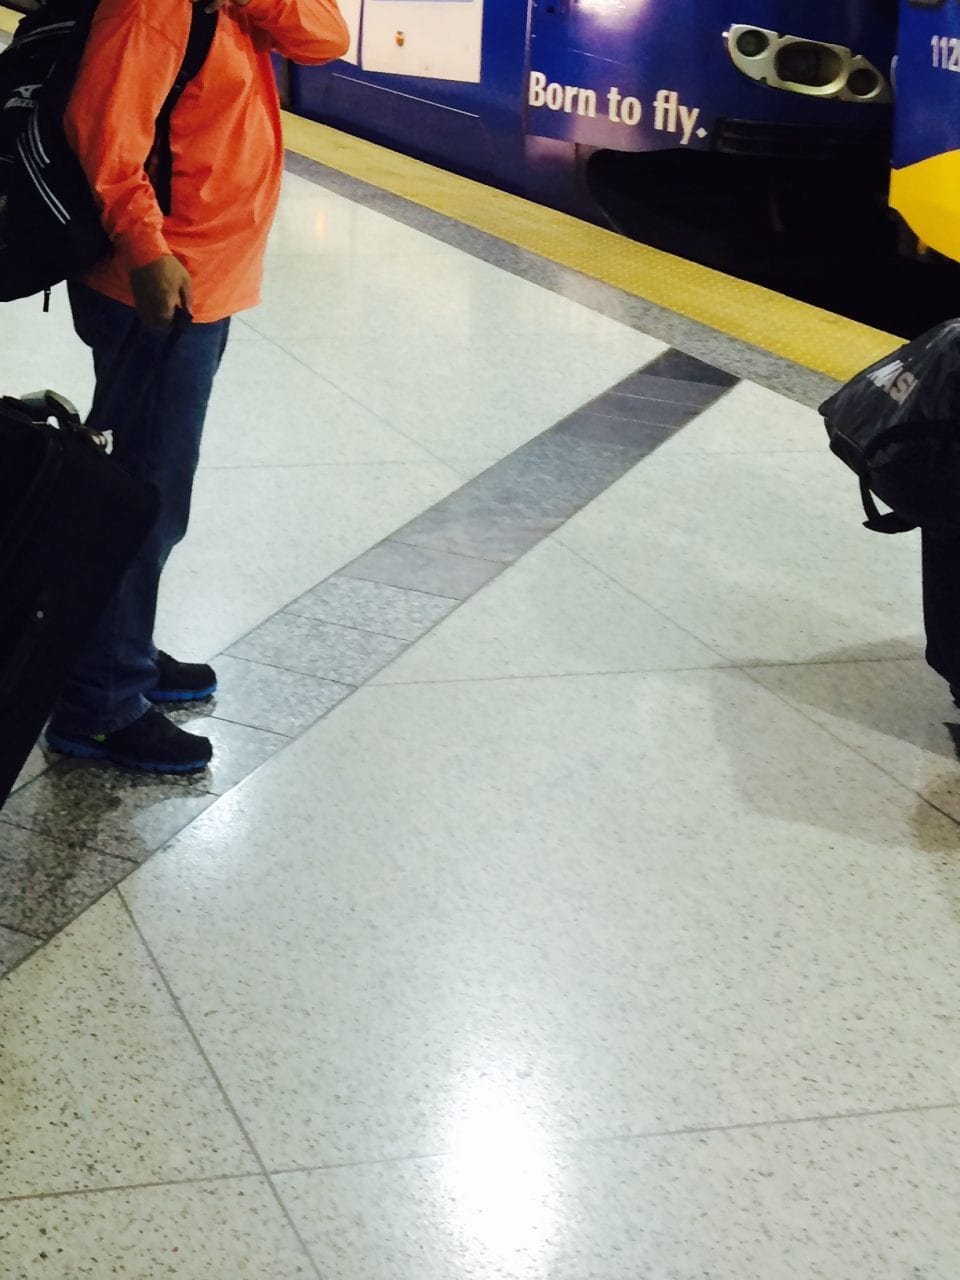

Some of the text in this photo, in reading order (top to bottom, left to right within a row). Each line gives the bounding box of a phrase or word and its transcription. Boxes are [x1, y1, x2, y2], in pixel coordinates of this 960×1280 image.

[528, 70, 708, 145] Born to fly.
